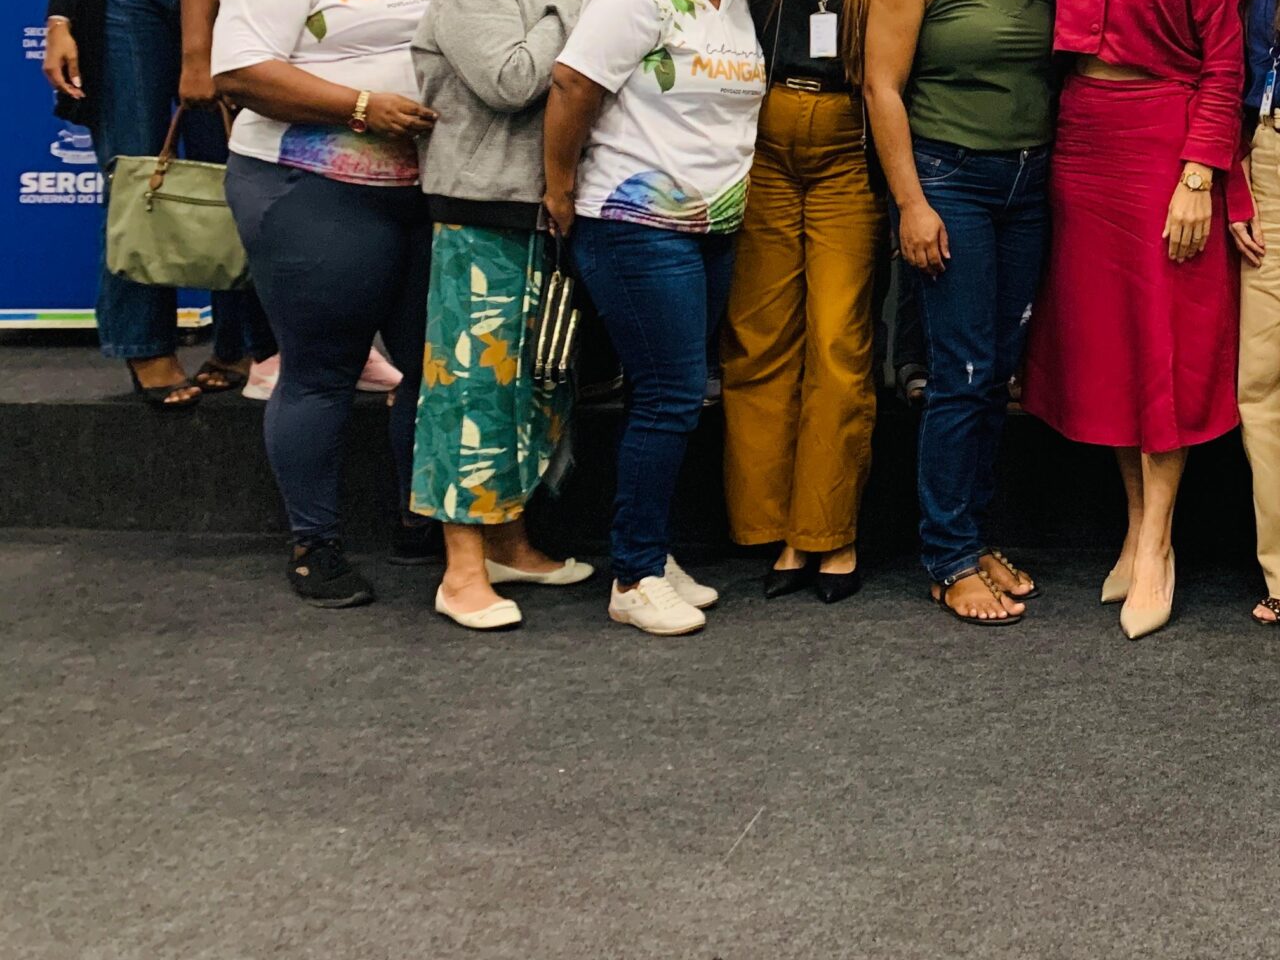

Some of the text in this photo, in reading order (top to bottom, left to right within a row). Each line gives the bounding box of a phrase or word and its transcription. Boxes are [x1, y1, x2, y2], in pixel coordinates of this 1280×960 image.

[20, 171, 104, 194] SERGI
[19, 194, 76, 204] GOVERNO
[77, 194, 95, 204] DO
